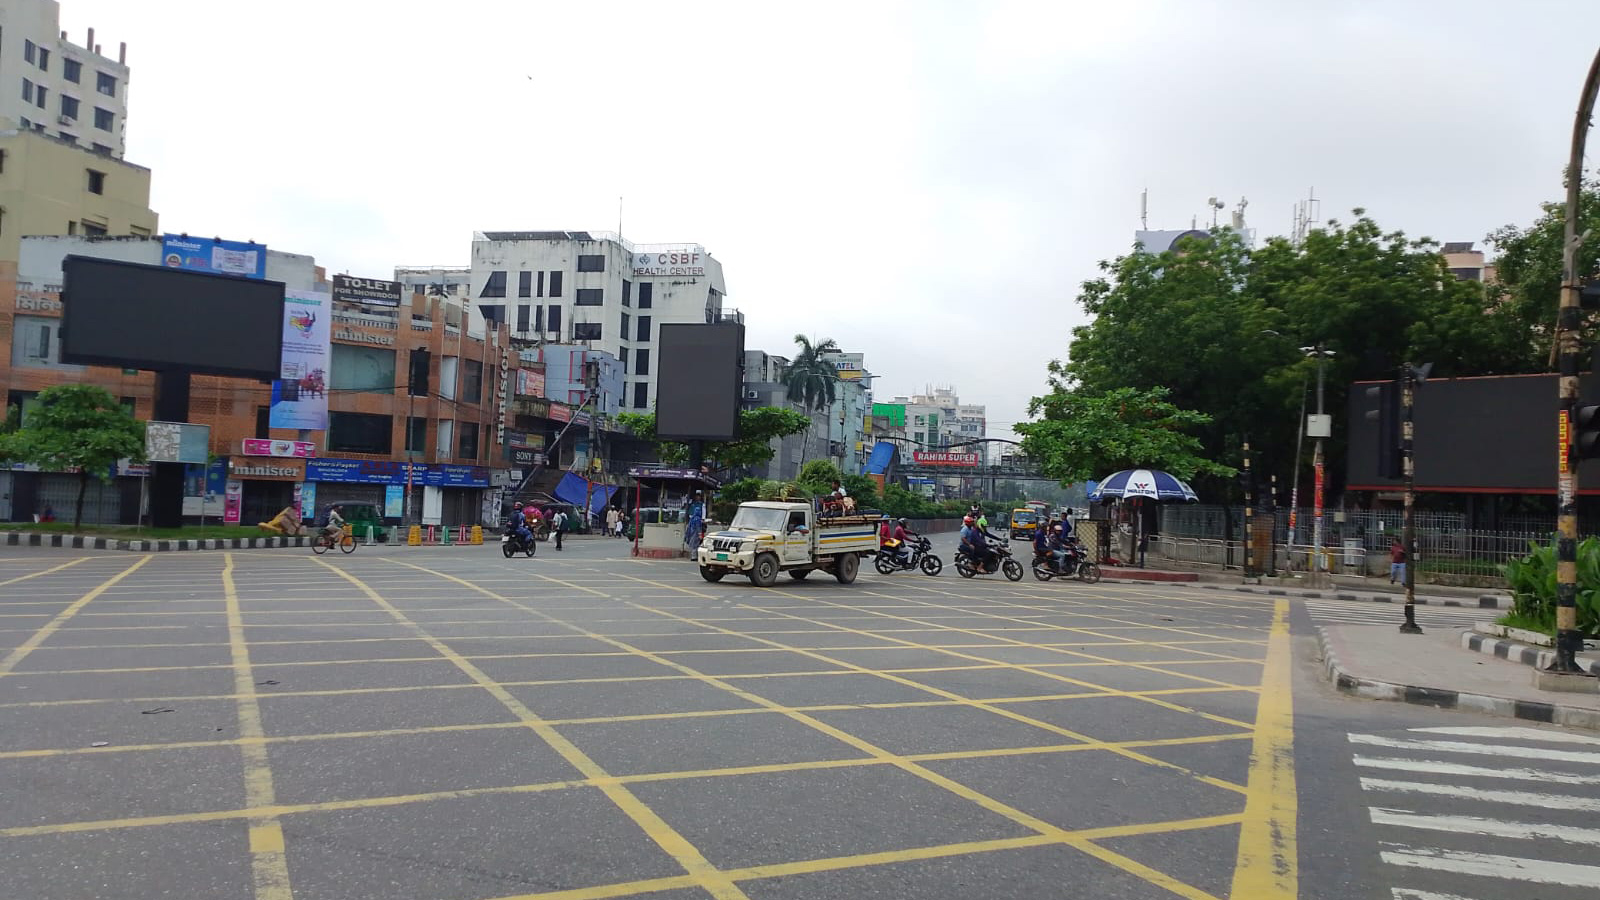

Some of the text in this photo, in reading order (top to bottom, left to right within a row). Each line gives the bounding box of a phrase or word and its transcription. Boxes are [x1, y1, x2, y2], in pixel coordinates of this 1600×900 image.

[658, 253, 700, 265] CSBF
[633, 266, 704, 275] HEALTH CENTER
[342, 277, 392, 291] TO-LET
[336, 330, 393, 345] minister
[516, 451, 533, 461] SONY
[918, 453, 975, 462] RAHIM SUPER
[234, 464, 300, 477] minister
